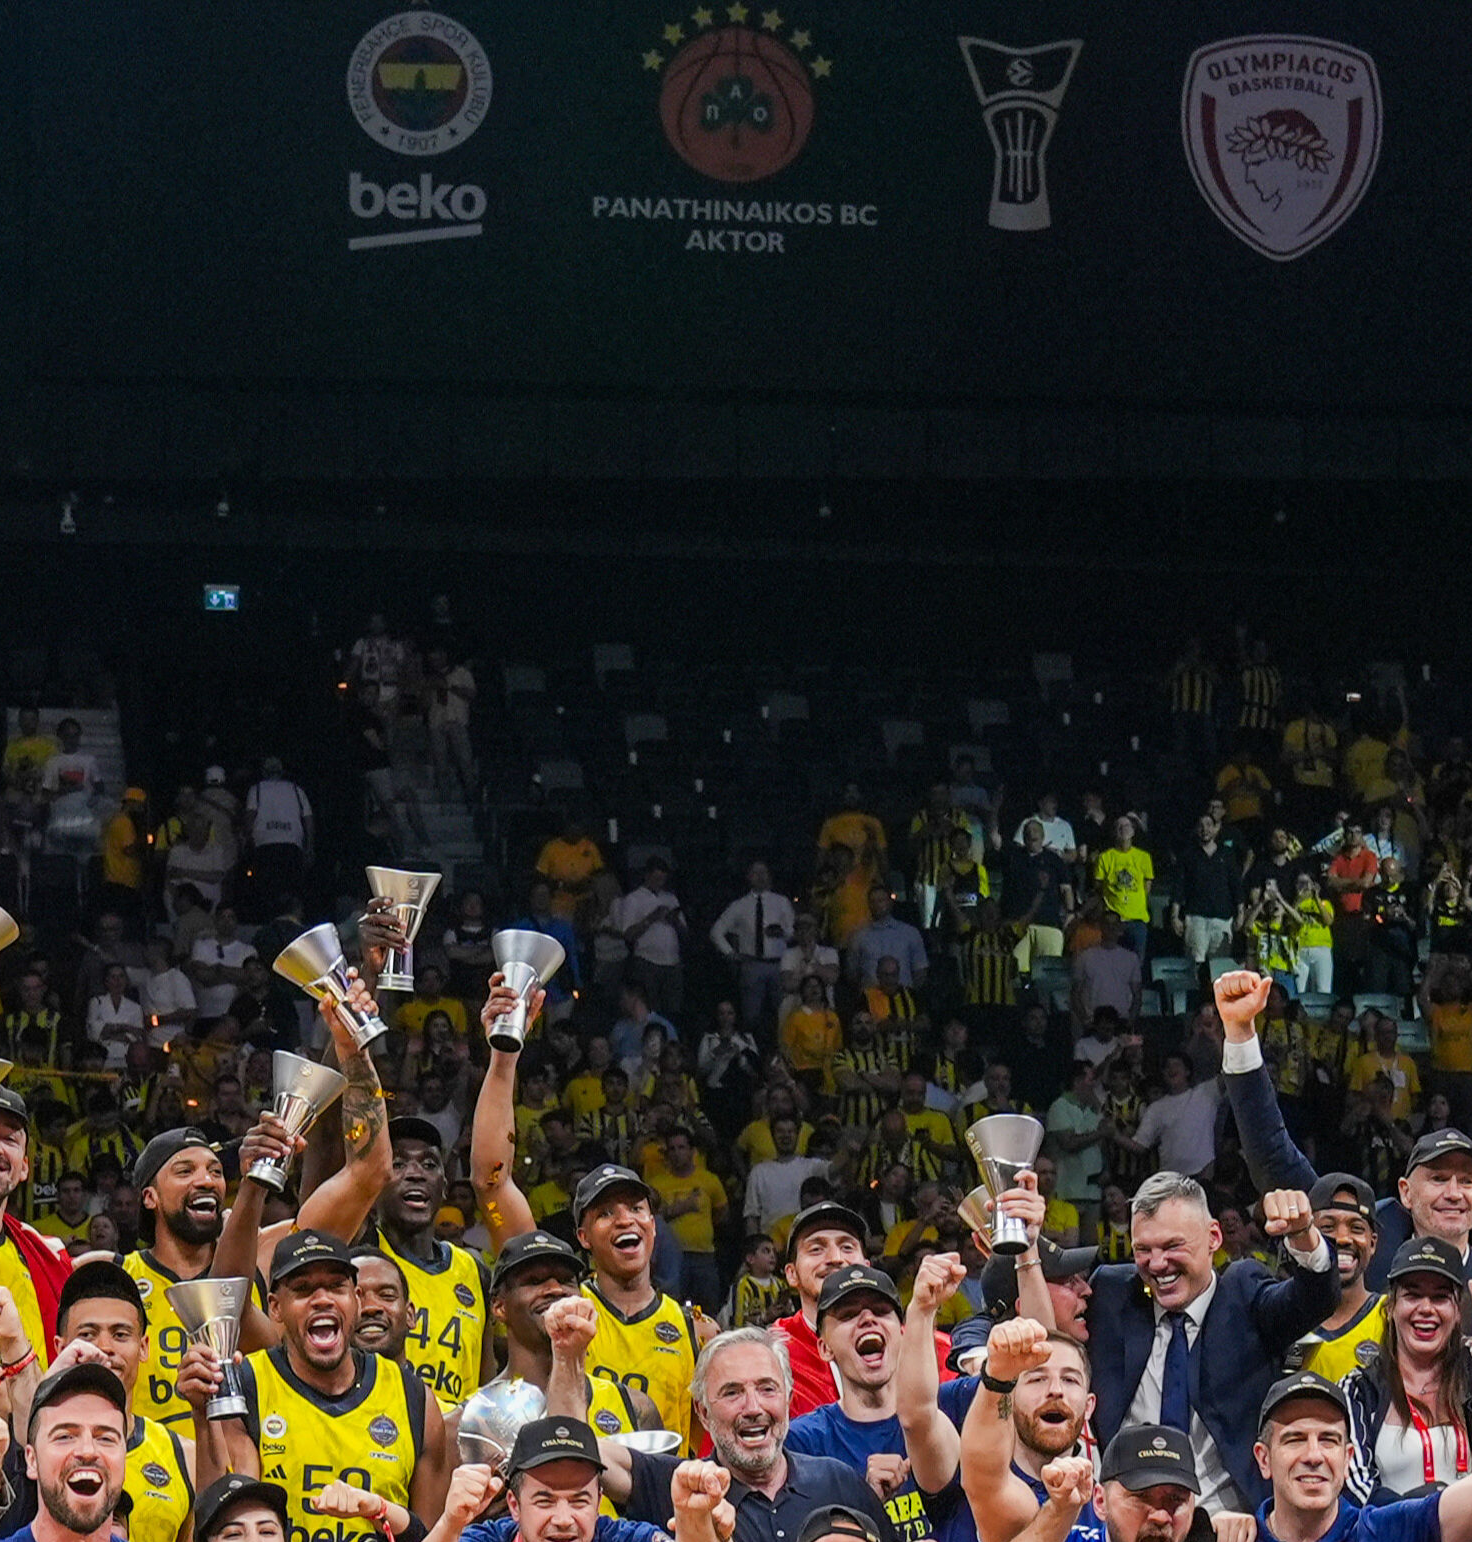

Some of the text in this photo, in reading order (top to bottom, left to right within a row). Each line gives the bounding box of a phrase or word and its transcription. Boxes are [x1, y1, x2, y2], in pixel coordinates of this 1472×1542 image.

[1207, 53, 1358, 84] OLYMPIACOS
[1228, 76, 1336, 100] BASKETBALL
[349, 171, 488, 221] beko
[592, 196, 879, 226] PANATHINAIKOS BC
[685, 229, 785, 254] AKTOR
[33, 1181, 58, 1196] bek
[1138, 1448, 1181, 1460] CHAMPIONS
